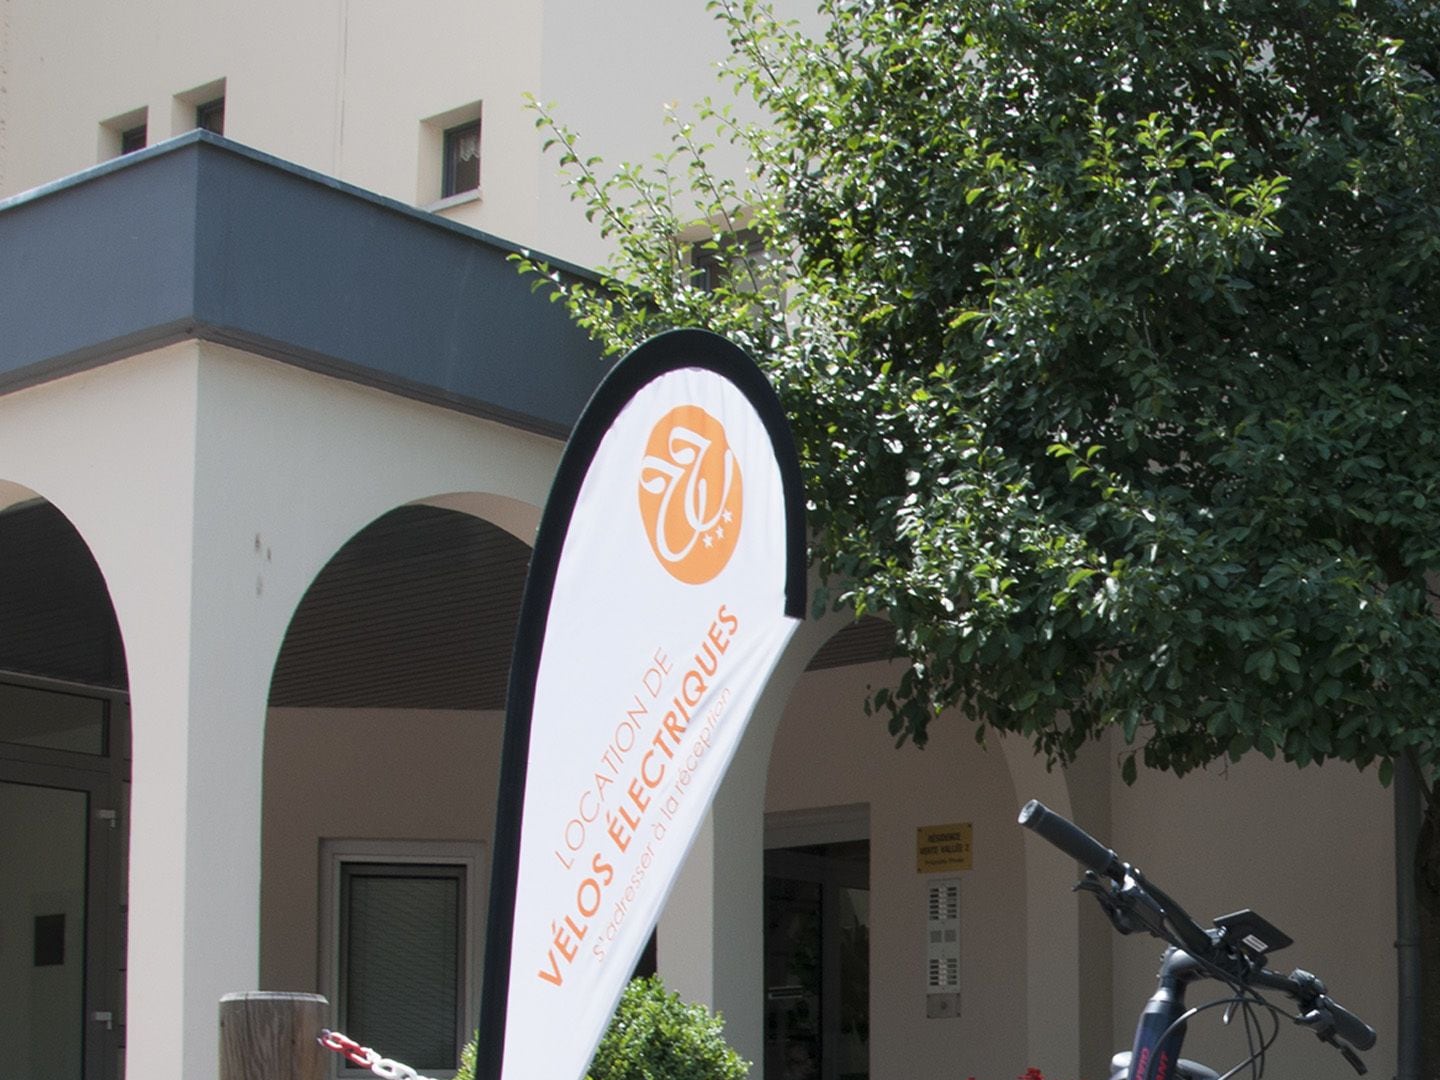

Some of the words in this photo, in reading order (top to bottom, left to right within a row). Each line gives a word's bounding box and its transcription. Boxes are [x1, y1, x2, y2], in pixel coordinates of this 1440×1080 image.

[537, 852, 615, 988] VÉLOS
[605, 603, 739, 854] ÉLECTRIQUES
[554, 694, 649, 871] LOCATION
[642, 646, 674, 700] DE
[592, 843, 656, 965] s'adresser
[652, 822, 667, 842] à
[662, 797, 679, 822] la
[675, 687, 732, 799] réception
